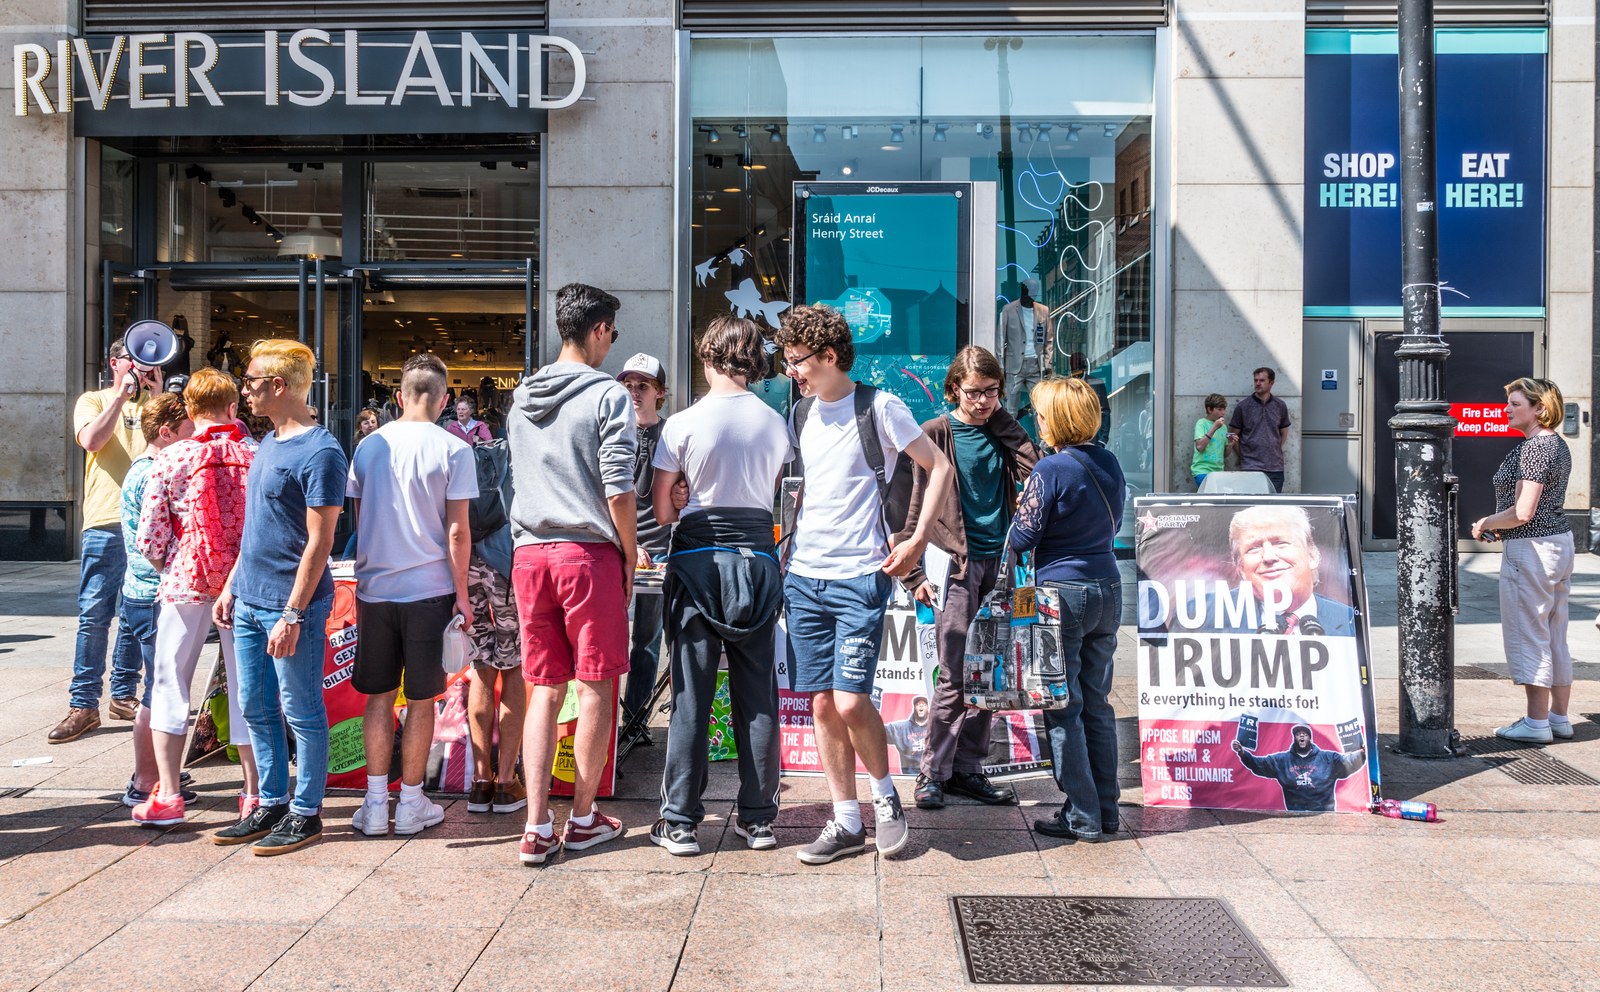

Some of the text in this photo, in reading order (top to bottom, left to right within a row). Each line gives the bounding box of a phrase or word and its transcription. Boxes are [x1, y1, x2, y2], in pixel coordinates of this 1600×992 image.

[14, 28, 586, 117] RIVER ISLAND
[1323, 153, 1395, 178] SHOP
[1462, 153, 1510, 178] EAT
[1320, 183, 1398, 208] HERE!
[1445, 183, 1524, 208] HERE!
[812, 213, 876, 223] Sráid Anraí
[812, 229, 884, 241] Henry Street
[1462, 408, 1502, 418] Fire Exit
[1457, 422, 1509, 434] Keep Clear
[1158, 514, 1200, 522] SOCIALIST
[1138, 579, 1292, 630] DUMP
[335, 646, 355, 664] SEX
[777, 663, 786, 675] &
[1140, 637, 1329, 690] TRUMP
[876, 667, 915, 680] stands
[1140, 693, 1319, 709] & everything he stands for!
[780, 715, 788, 728] &
[783, 733, 799, 746] THE
[1142, 728, 1178, 743] OPPOSE
[1182, 730, 1221, 744] RACISM
[789, 750, 818, 765] CLASS
[1146, 748, 1211, 763] & SEXISM &
[1152, 766, 1234, 783] THE BILLIONAIRE
[1161, 785, 1193, 800] CLASS
